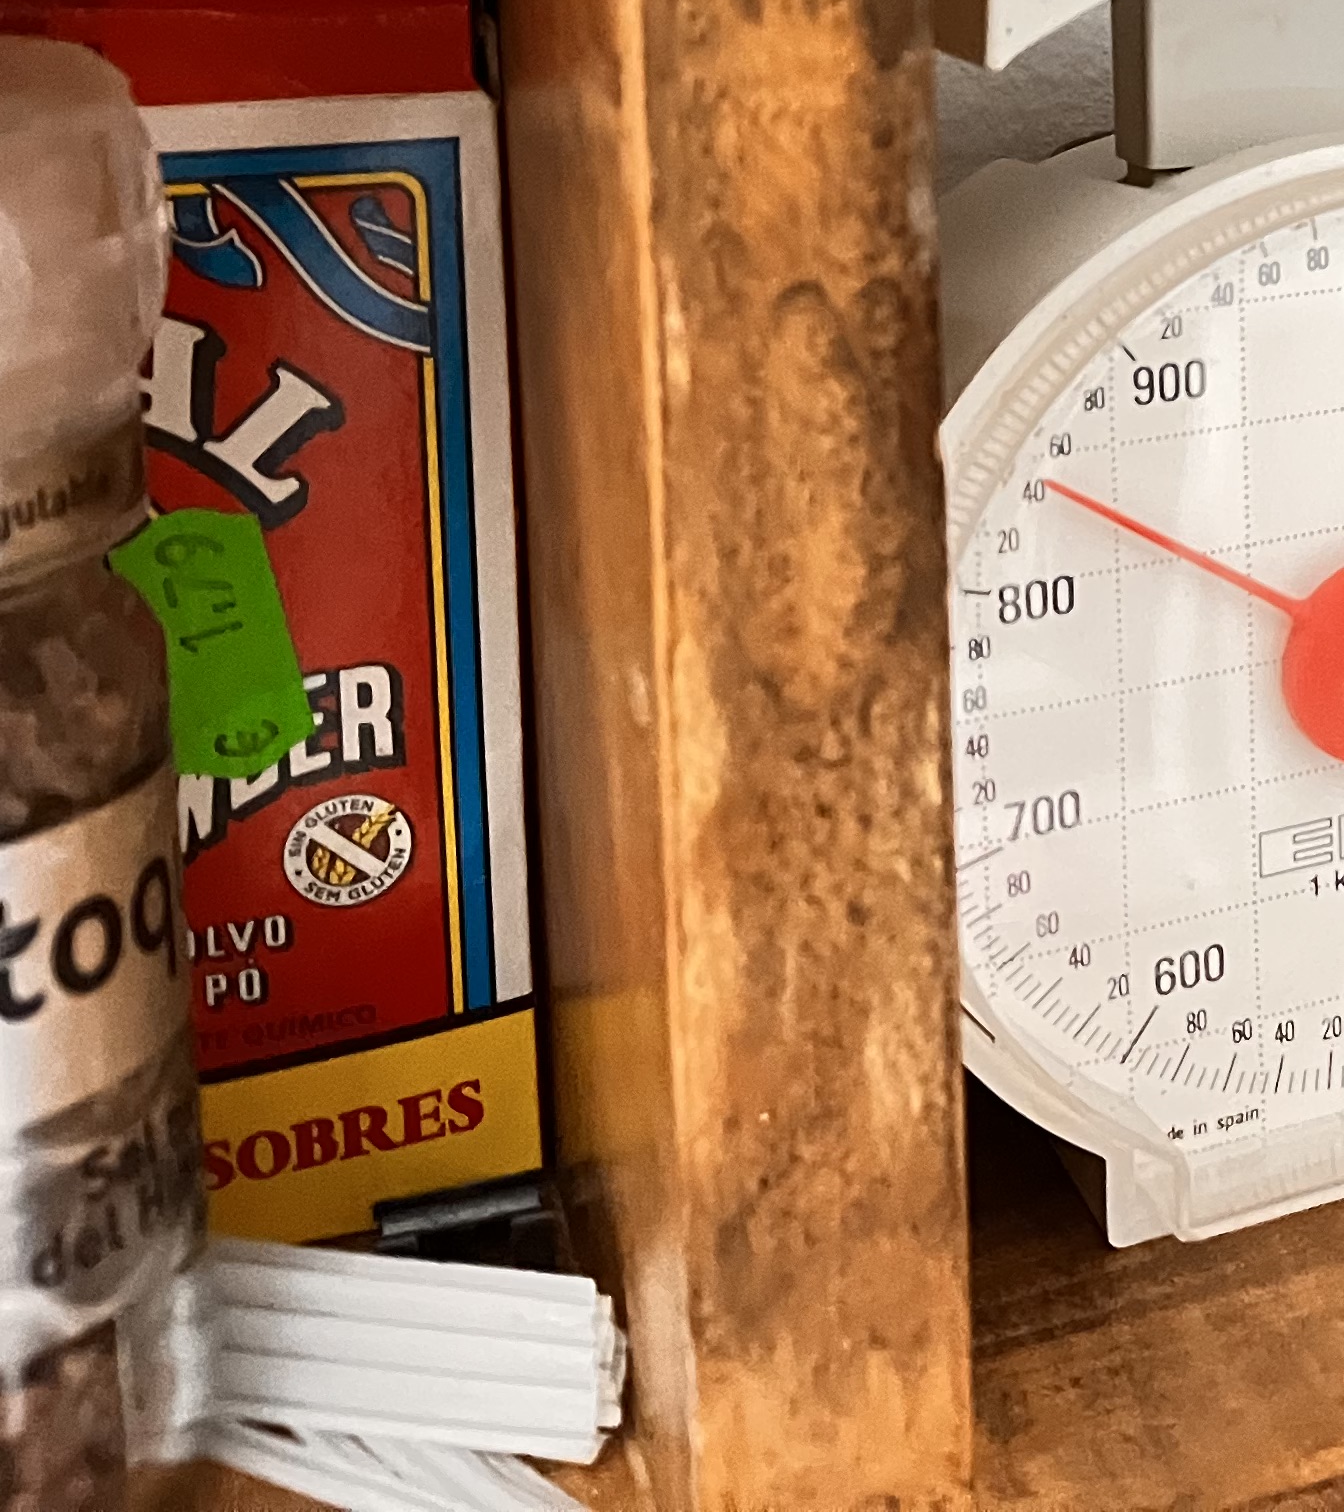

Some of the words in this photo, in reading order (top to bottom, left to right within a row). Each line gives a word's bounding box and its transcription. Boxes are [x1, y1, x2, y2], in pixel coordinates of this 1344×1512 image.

[1306, 245, 1330, 271] 80
[1257, 261, 1281, 286] 60
[1210, 281, 1234, 307] 40
[1160, 315, 1182, 340] 20
[1132, 358, 1207, 406] 900
[1083, 386, 1106, 412] 80
[1048, 433, 1073, 459] 60
[1021, 479, 1046, 504] 40
[997, 526, 1020, 555] 20
[998, 575, 1075, 625] 800
[967, 635, 991, 661] 80
[962, 685, 987, 714] 60
[965, 733, 989, 760] 40
[972, 778, 996, 806] 20
[288, 830, 307, 857] SIN
[304, 798, 375, 828] GLUTEN
[1003, 789, 1081, 841] 700
[303, 881, 341, 902] SEM
[347, 847, 407, 900] GLUTEN
[1006, 870, 1031, 897] 80
[1310, 874, 1319, 897] 1
[1035, 911, 1060, 938] 60
[1068, 943, 1092, 970] 40
[1154, 943, 1225, 996] 600
[1107, 973, 1130, 1000] 20
[1186, 1008, 1208, 1033] 80
[1231, 1018, 1253, 1043] 60
[1274, 1019, 1296, 1043] 40
[1321, 1015, 1343, 1040] 20
[1193, 1118, 1208, 1136] in
[1216, 1105, 1260, 1132] spain
[203, 1079, 484, 1191] SOBRES
